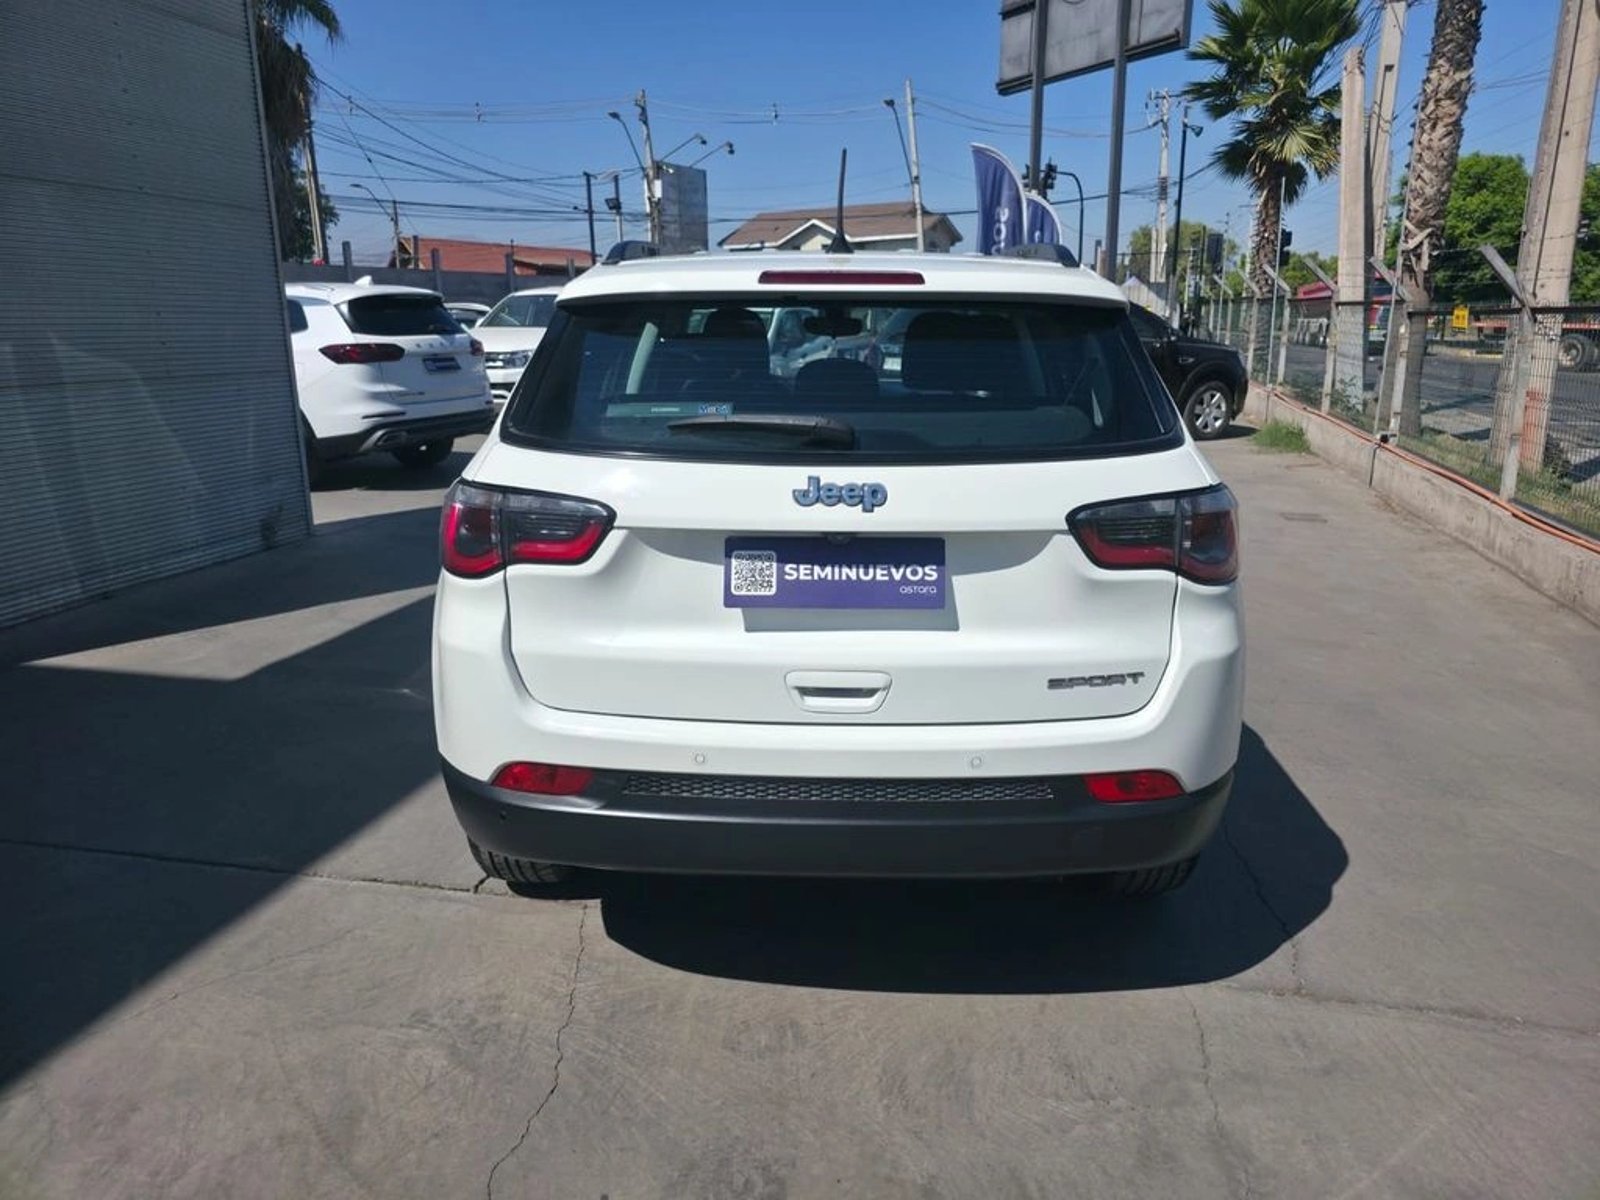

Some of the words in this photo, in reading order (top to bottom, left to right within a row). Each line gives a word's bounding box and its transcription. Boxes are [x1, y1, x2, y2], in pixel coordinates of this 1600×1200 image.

[793, 475, 888, 513] Jeep
[783, 564, 938, 581] SEMINUEVOS
[899, 585, 937, 594] astara
[1047, 671, 1145, 690] SPORT
